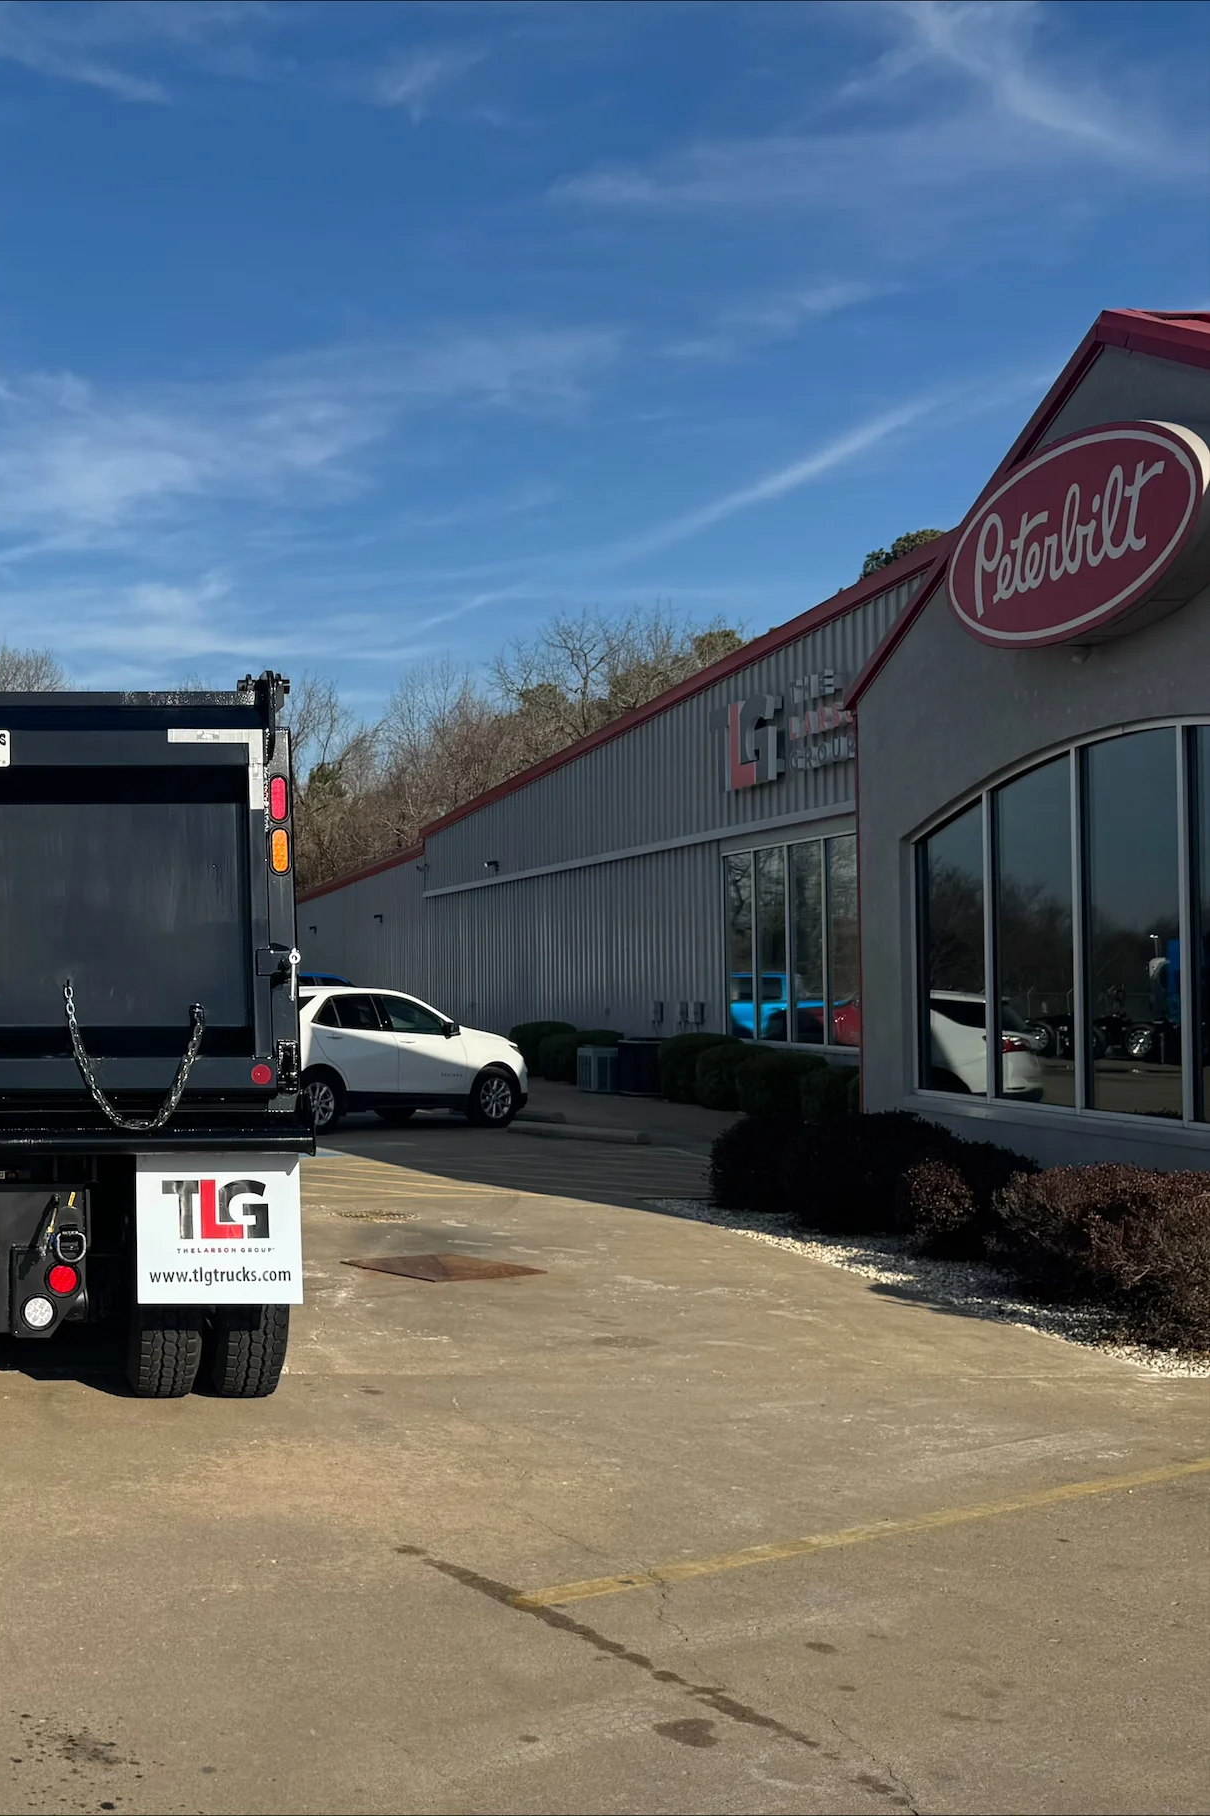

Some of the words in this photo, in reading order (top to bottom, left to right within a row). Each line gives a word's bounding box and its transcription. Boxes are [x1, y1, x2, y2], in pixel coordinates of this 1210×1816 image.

[974, 459, 1166, 618] Peterbilt
[709, 694, 782, 792] TLG
[162, 1179, 270, 1239] TLG
[149, 1266, 291, 1286] www.tlgtrucks.com
